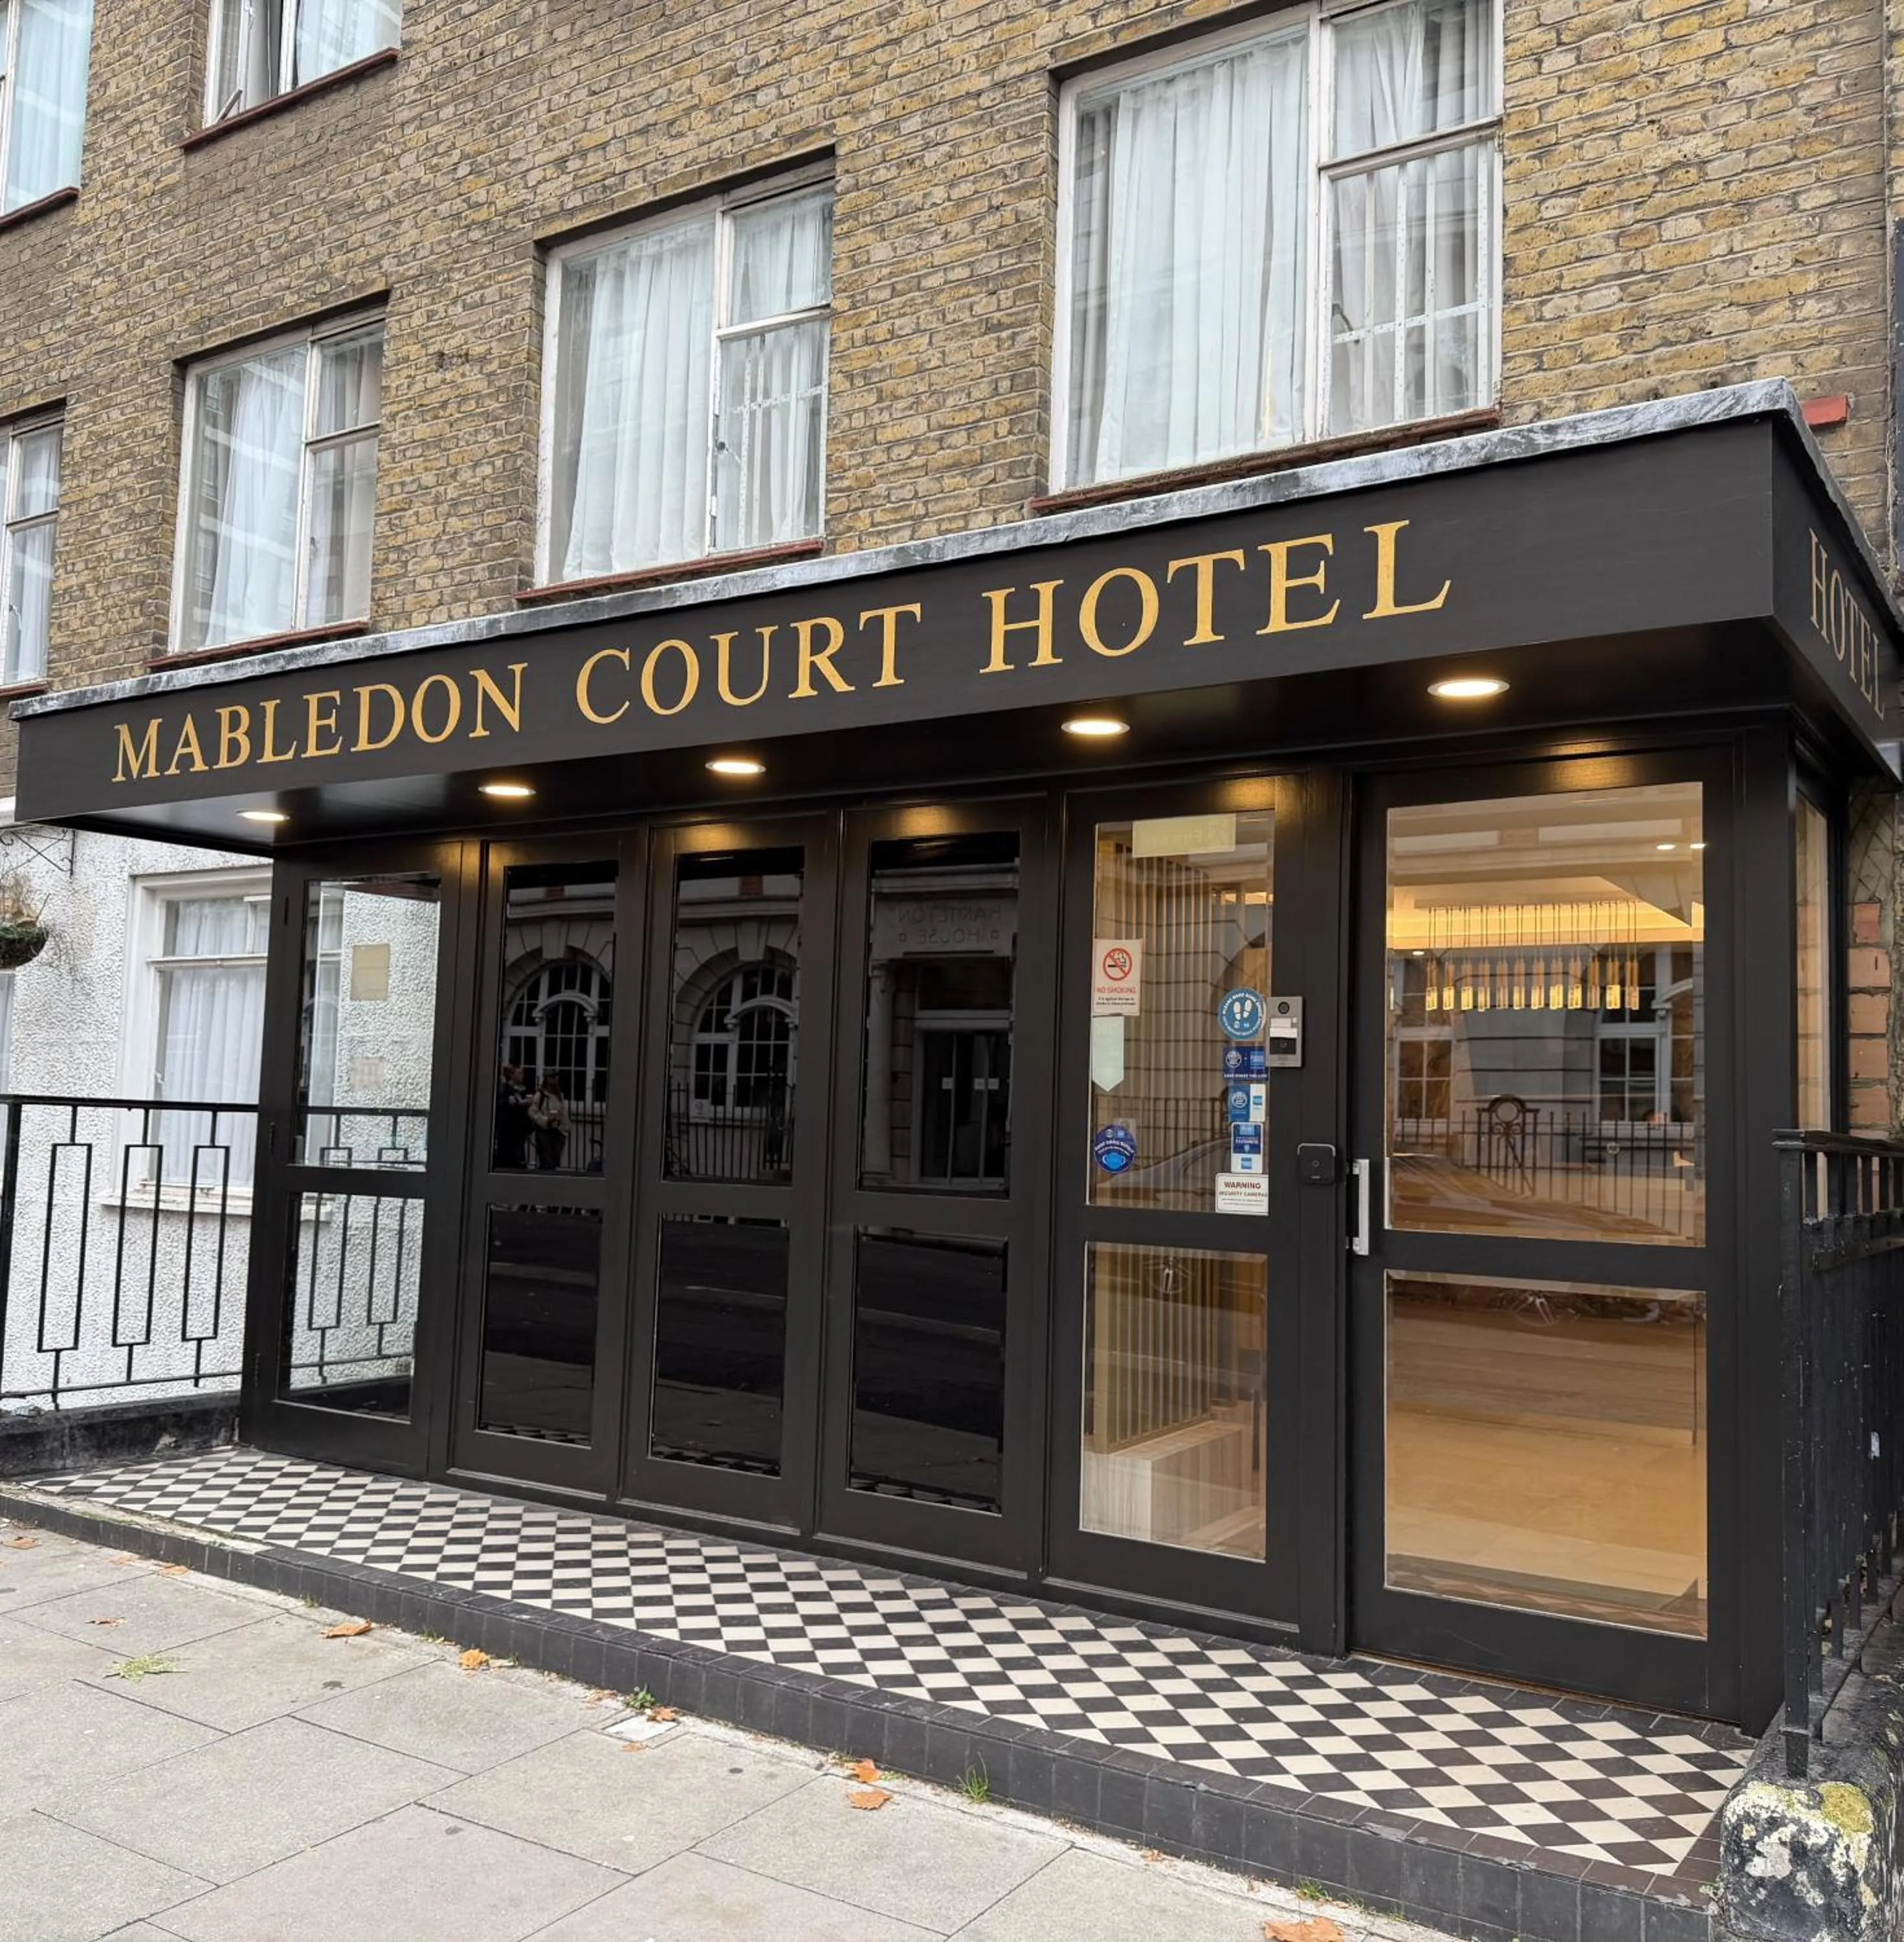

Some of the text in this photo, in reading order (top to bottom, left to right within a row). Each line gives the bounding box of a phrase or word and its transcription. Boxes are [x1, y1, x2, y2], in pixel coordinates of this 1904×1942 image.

[112, 520, 1452, 783] MABLEDON COURT HOTEL
[1809, 527, 1885, 723] HOTEL
[1224, 1181, 1261, 1190] WARNING
